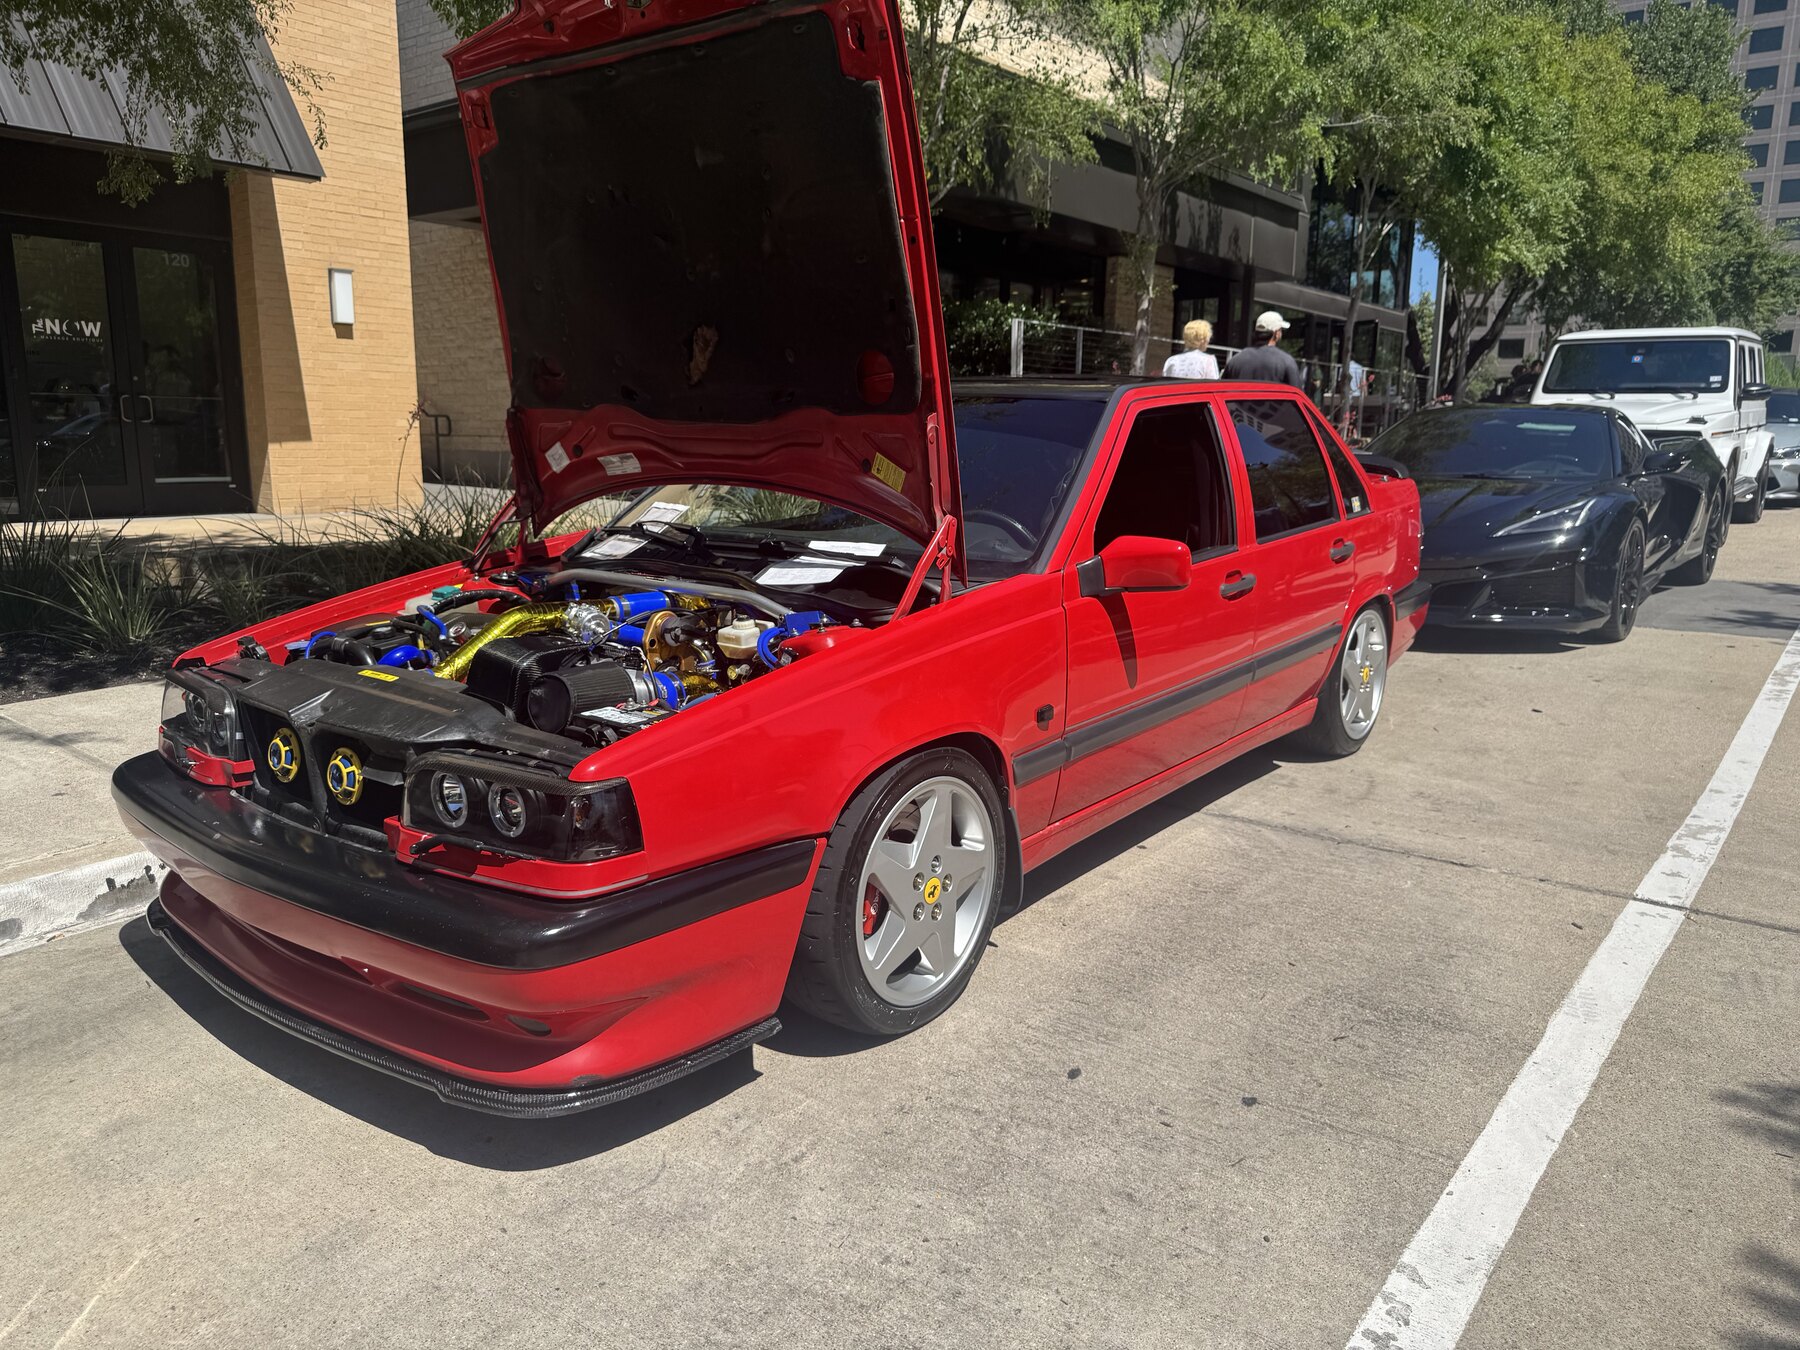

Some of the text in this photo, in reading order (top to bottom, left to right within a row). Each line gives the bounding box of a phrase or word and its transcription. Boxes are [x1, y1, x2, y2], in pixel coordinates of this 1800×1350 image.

[161, 252, 190, 268] 120
[32, 318, 101, 337] The NOW
